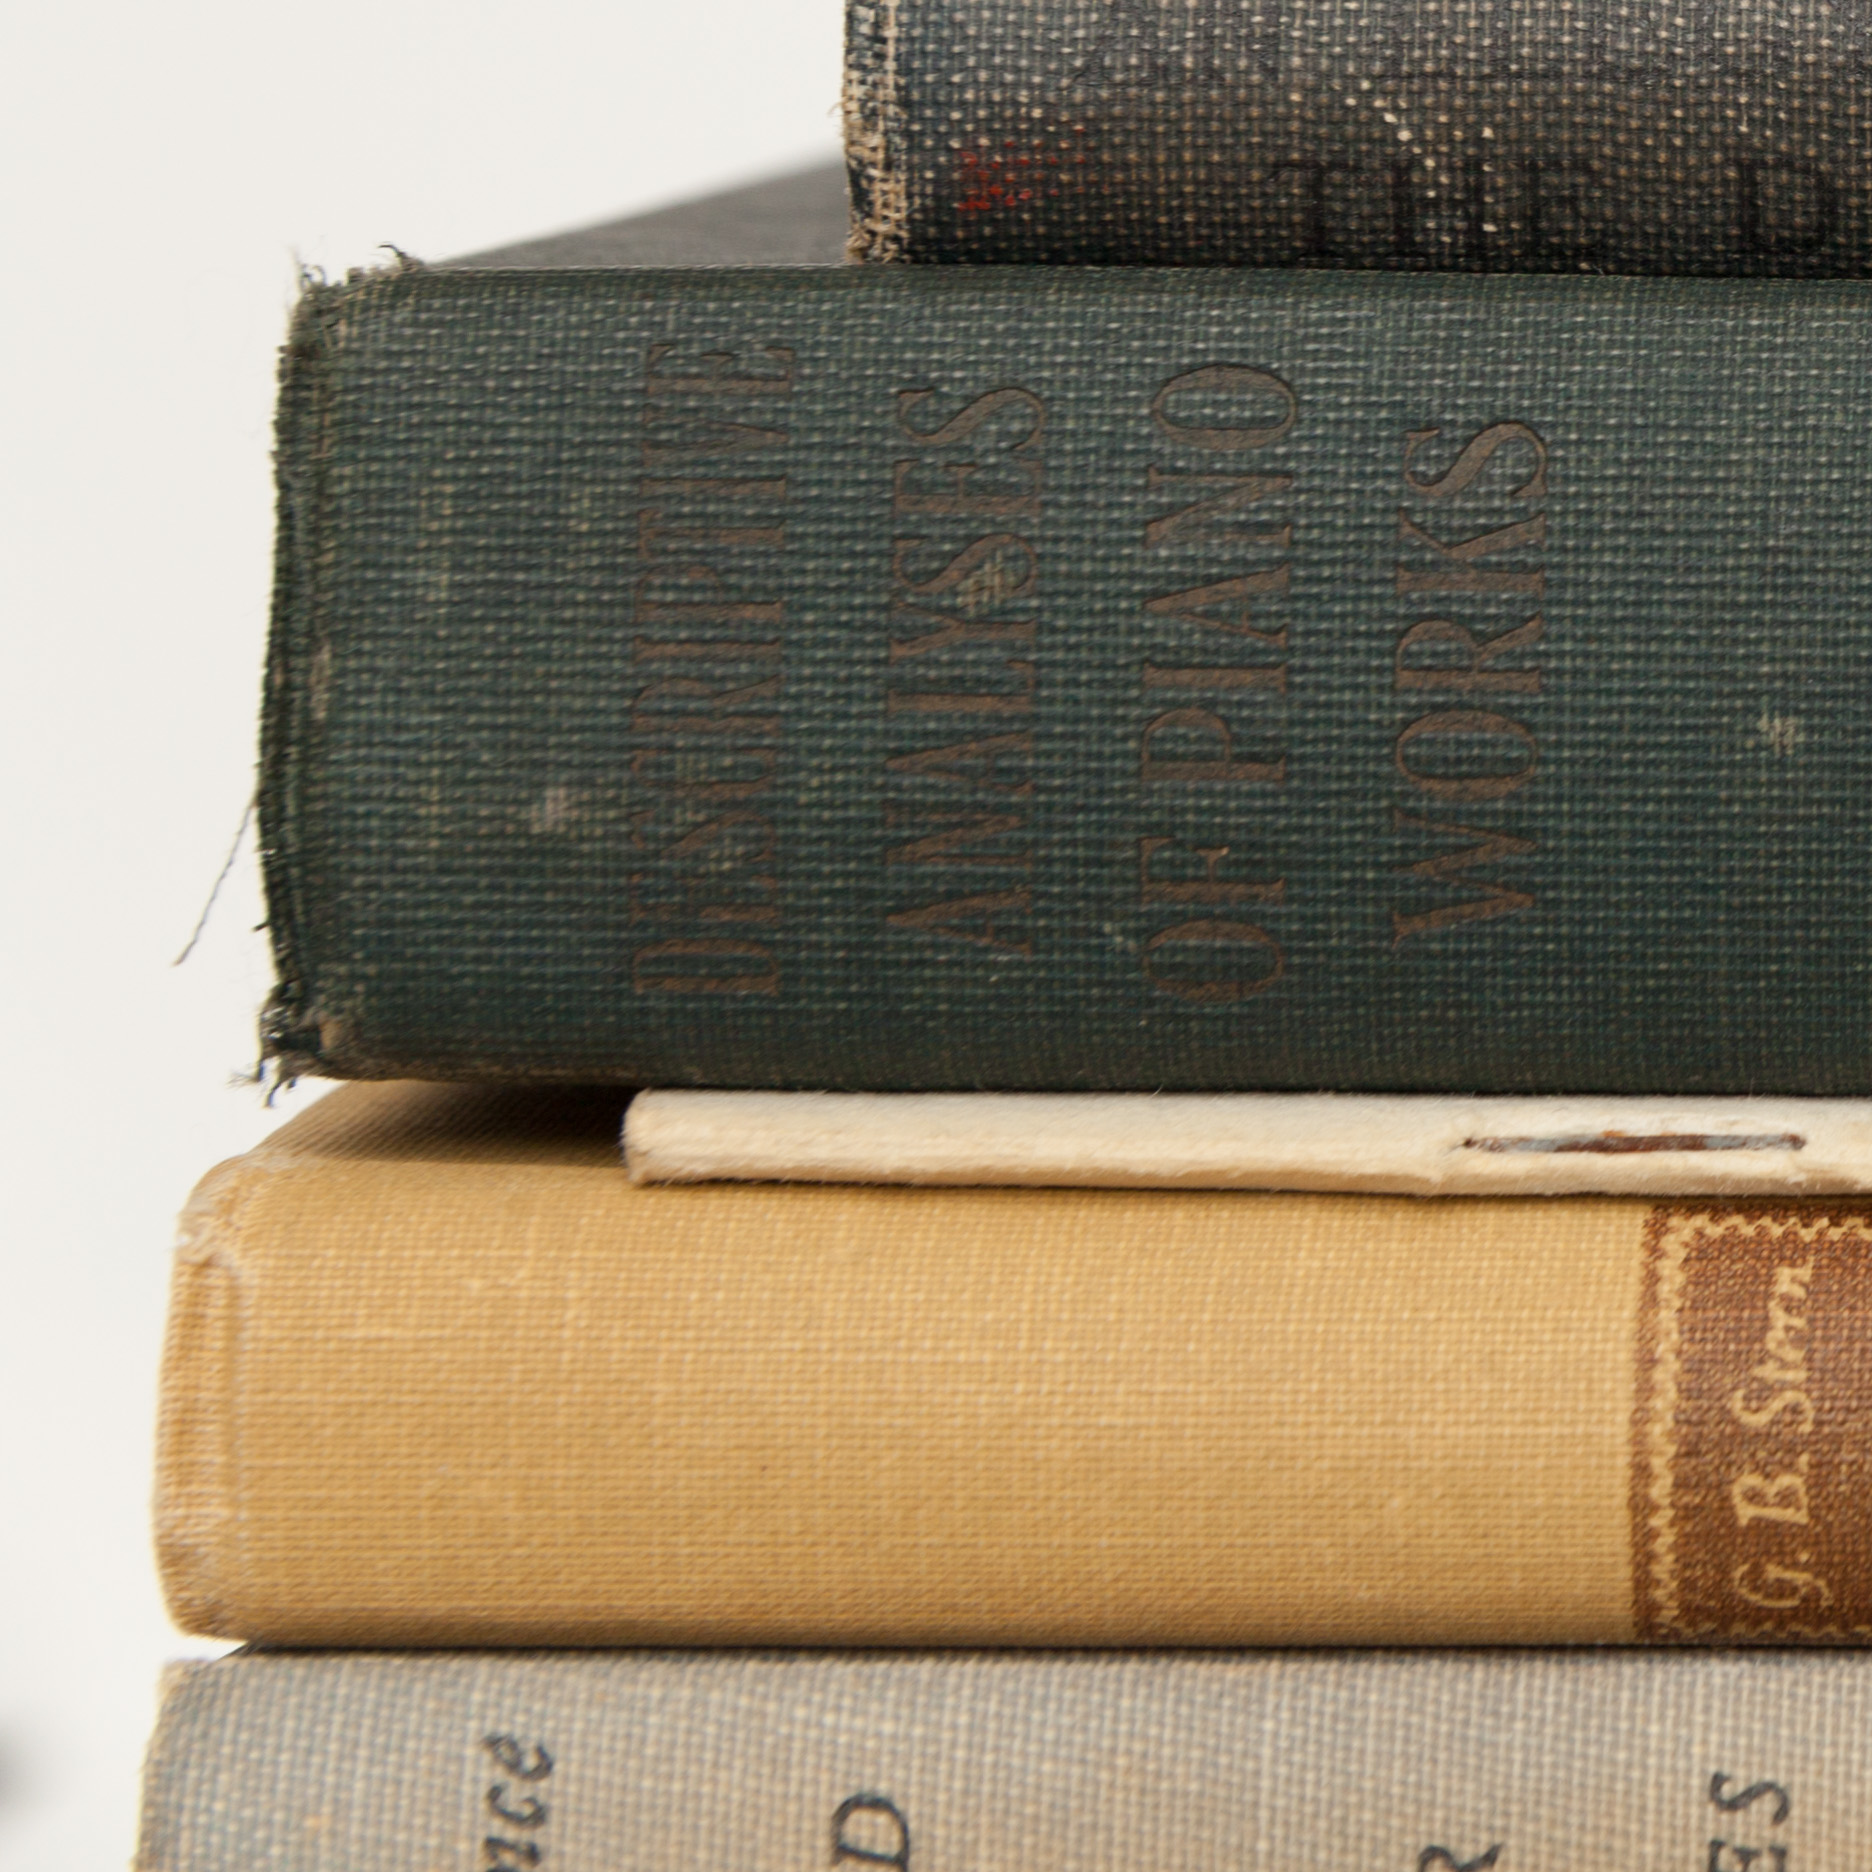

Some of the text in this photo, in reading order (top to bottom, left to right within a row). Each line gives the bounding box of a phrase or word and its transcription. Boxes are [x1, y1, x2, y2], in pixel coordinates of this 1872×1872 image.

[1265, 150, 1608, 260] THE
[630, 340, 798, 998] DESCRIPTIVE
[885, 384, 1048, 958] ANALYSES
[1138, 360, 1299, 1004] OF PIANO
[1393, 418, 1549, 948] WORKS
[1730, 1452, 1813, 1528] B.
